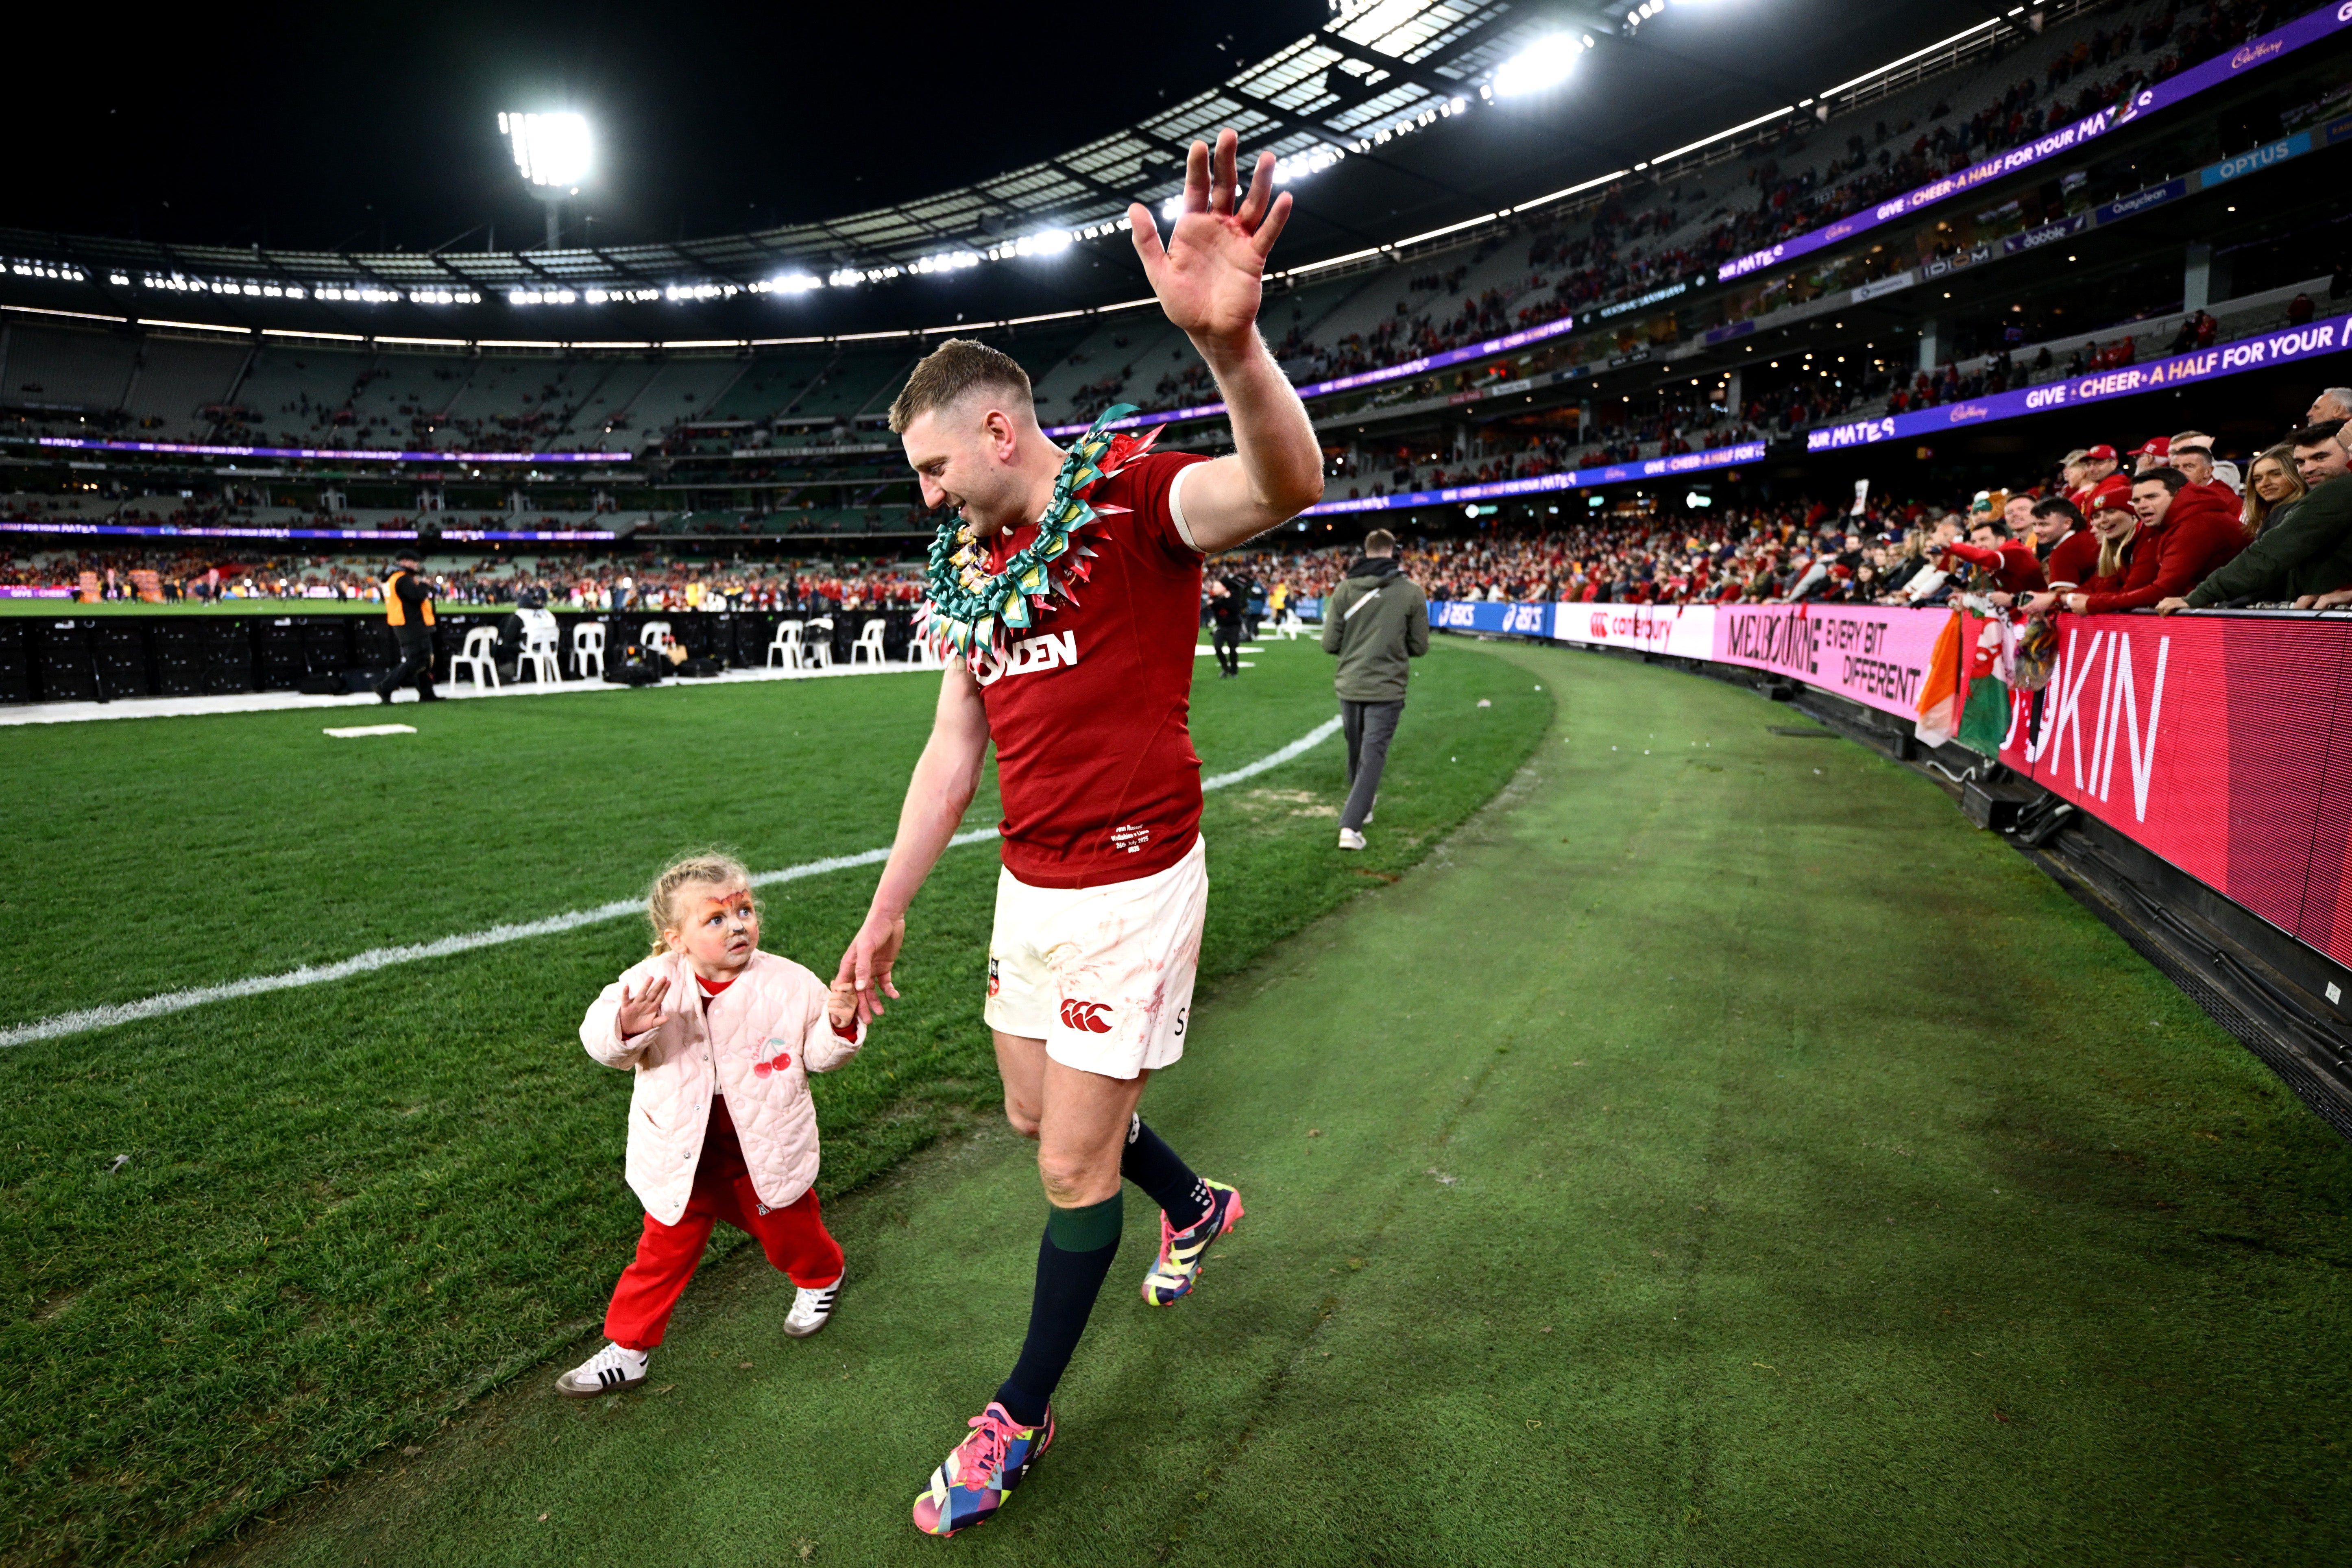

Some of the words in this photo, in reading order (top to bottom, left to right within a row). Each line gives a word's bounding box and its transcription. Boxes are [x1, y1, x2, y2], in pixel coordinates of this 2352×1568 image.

[2232, 39, 2283, 69] Cadbury
[1877, 198, 1905, 220] GIVE
[1912, 180, 1951, 206] CHEER
[1968, 159, 2003, 184] HALF
[2004, 146, 2033, 170] FOR
[2035, 128, 2074, 157] YOUR
[2220, 141, 2289, 178] OPTUS
[2112, 188, 2167, 214] Quayclean
[1923, 248, 1989, 277] IDIOM
[2026, 384, 2066, 408] GIVE
[2079, 370, 2140, 399] CHEER
[2149, 365, 2165, 385] A
[2168, 352, 2218, 381] HALF
[2222, 342, 2265, 369] FOR
[2268, 325, 2334, 358] YOUR
[1613, 616, 1674, 653] canterbury
[1728, 613, 1822, 675] MELBOURNE
[1826, 619, 1864, 649] EVERY
[1865, 621, 1888, 655] BIT
[1843, 655, 1921, 706] DIFFERENT
[1111, 833, 1134, 842] Wallabies
[1138, 835, 1149, 844] 2025
[756, 1203, 776, 1216] A
